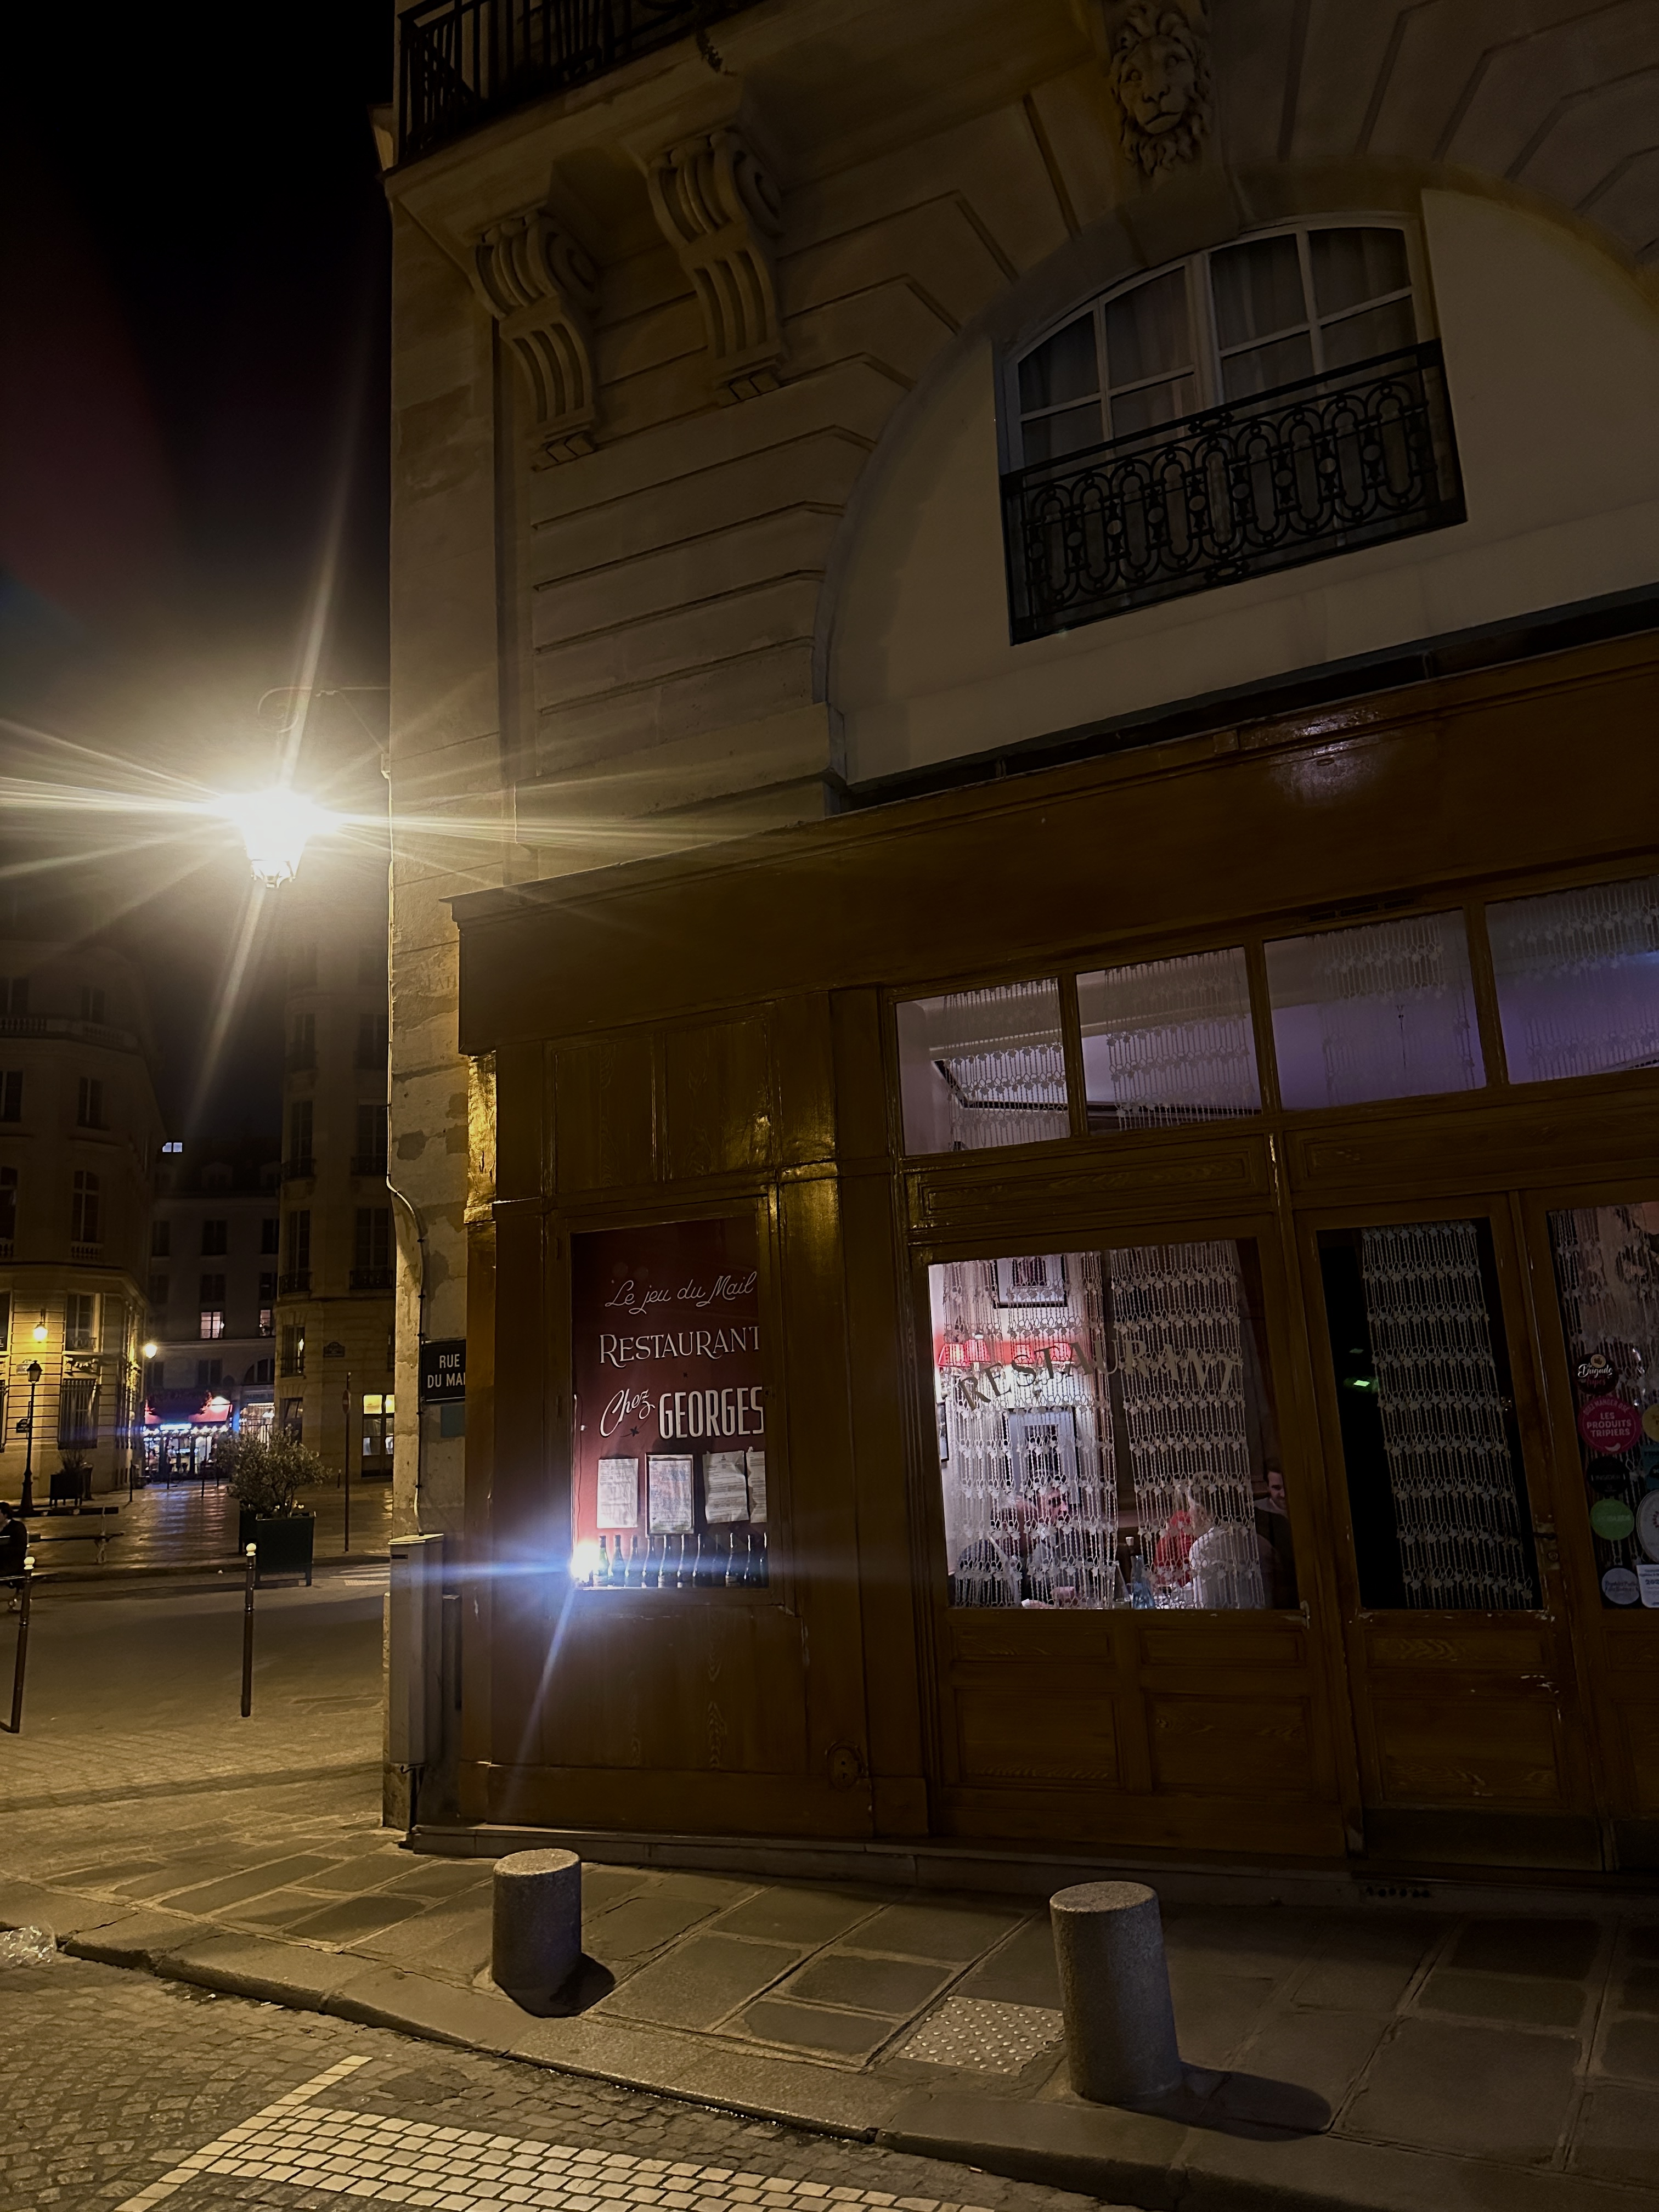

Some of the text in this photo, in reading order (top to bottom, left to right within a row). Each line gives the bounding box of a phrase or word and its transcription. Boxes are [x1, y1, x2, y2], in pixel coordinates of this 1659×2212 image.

[605, 1271, 757, 1314] Le jeu du Mail
[600, 1326, 760, 1368] RESTAURANT
[439, 1353, 460, 1369] RUE
[957, 1339, 1244, 1411] RESTAURANT
[1577, 1364, 1613, 1379] Brigade
[427, 1374, 442, 1389] DU
[600, 1386, 764, 1440] Chez GEORGES
[1600, 1411, 1615, 1420] LES
[1587, 1419, 1632, 1429] PRODUITS
[1590, 1427, 1630, 1437] TRIPIERS
